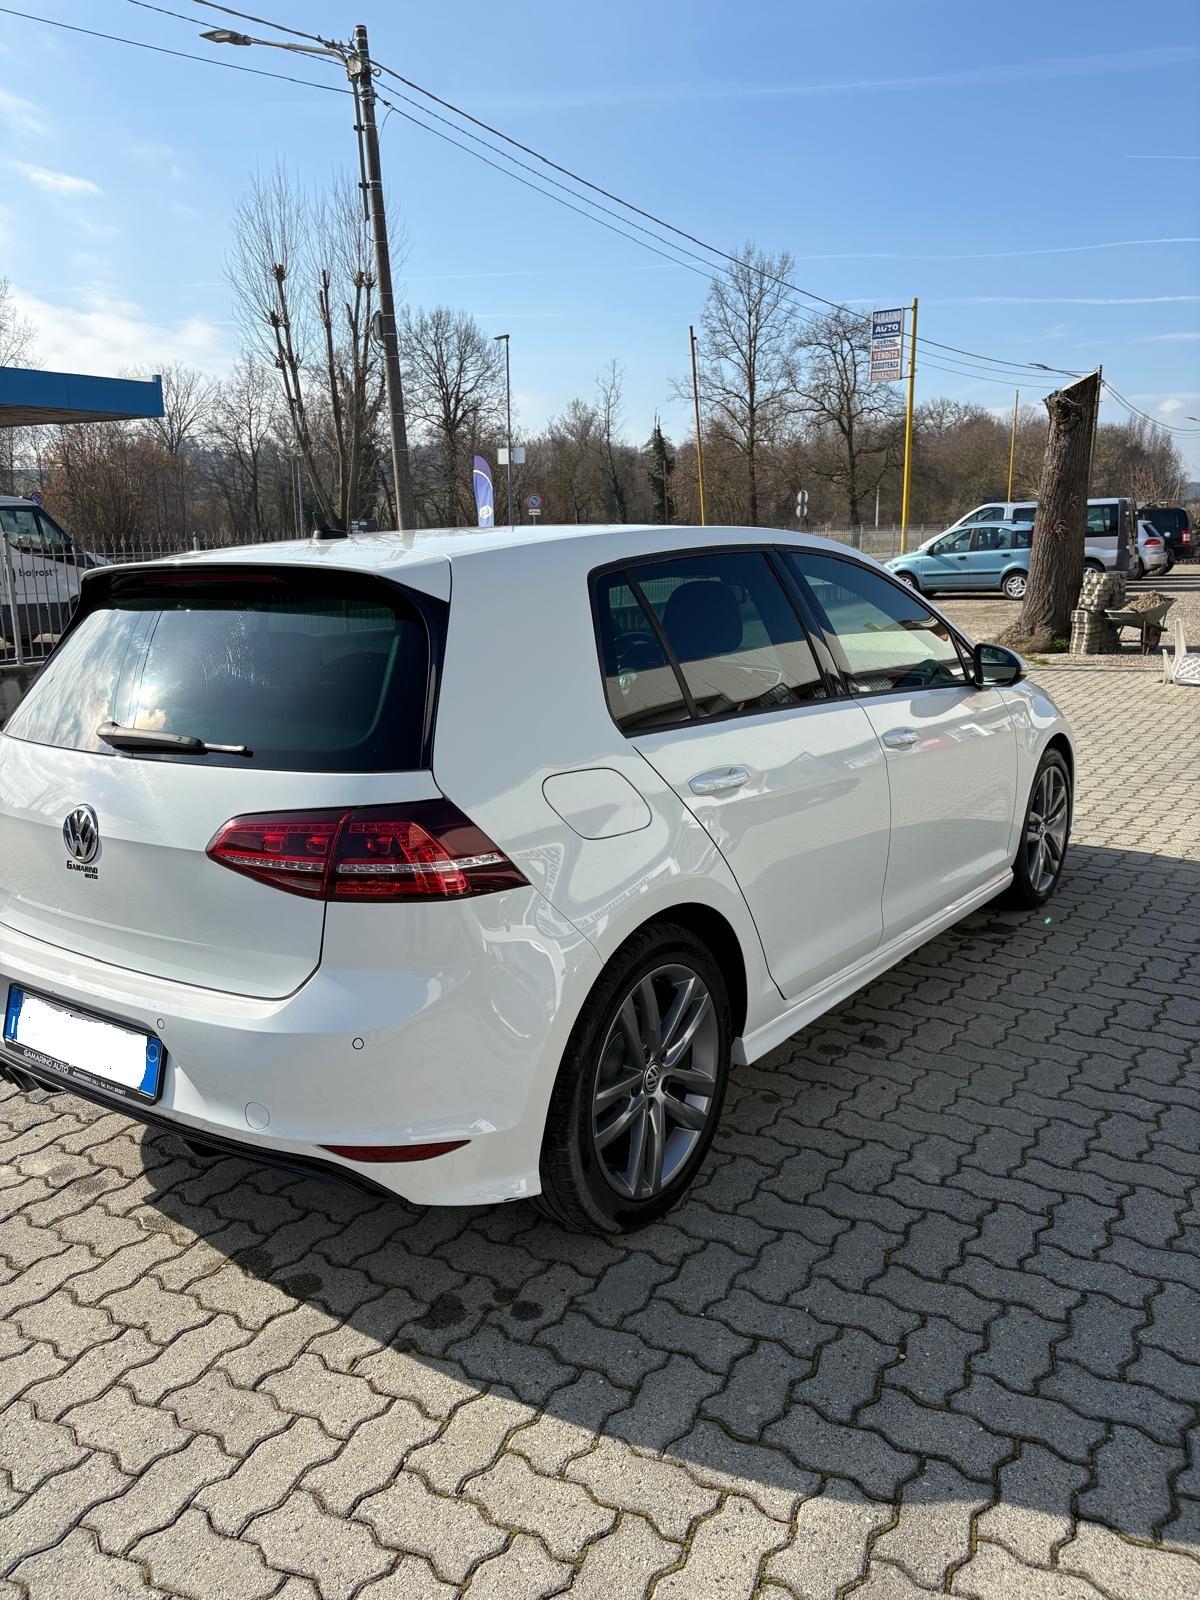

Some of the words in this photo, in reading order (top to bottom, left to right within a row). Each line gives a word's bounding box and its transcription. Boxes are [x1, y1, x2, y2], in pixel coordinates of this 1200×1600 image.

[875, 324, 899, 333] AUTO
[873, 351, 899, 360] VENDITA
[872, 361, 899, 370] ASSISTENZA
[18, 568, 54, 577] borost
[66, 860, 98, 874] GAMARINO
[23, 1049, 53, 1067] GAMARINO
[53, 1062, 69, 1074] AUTO
